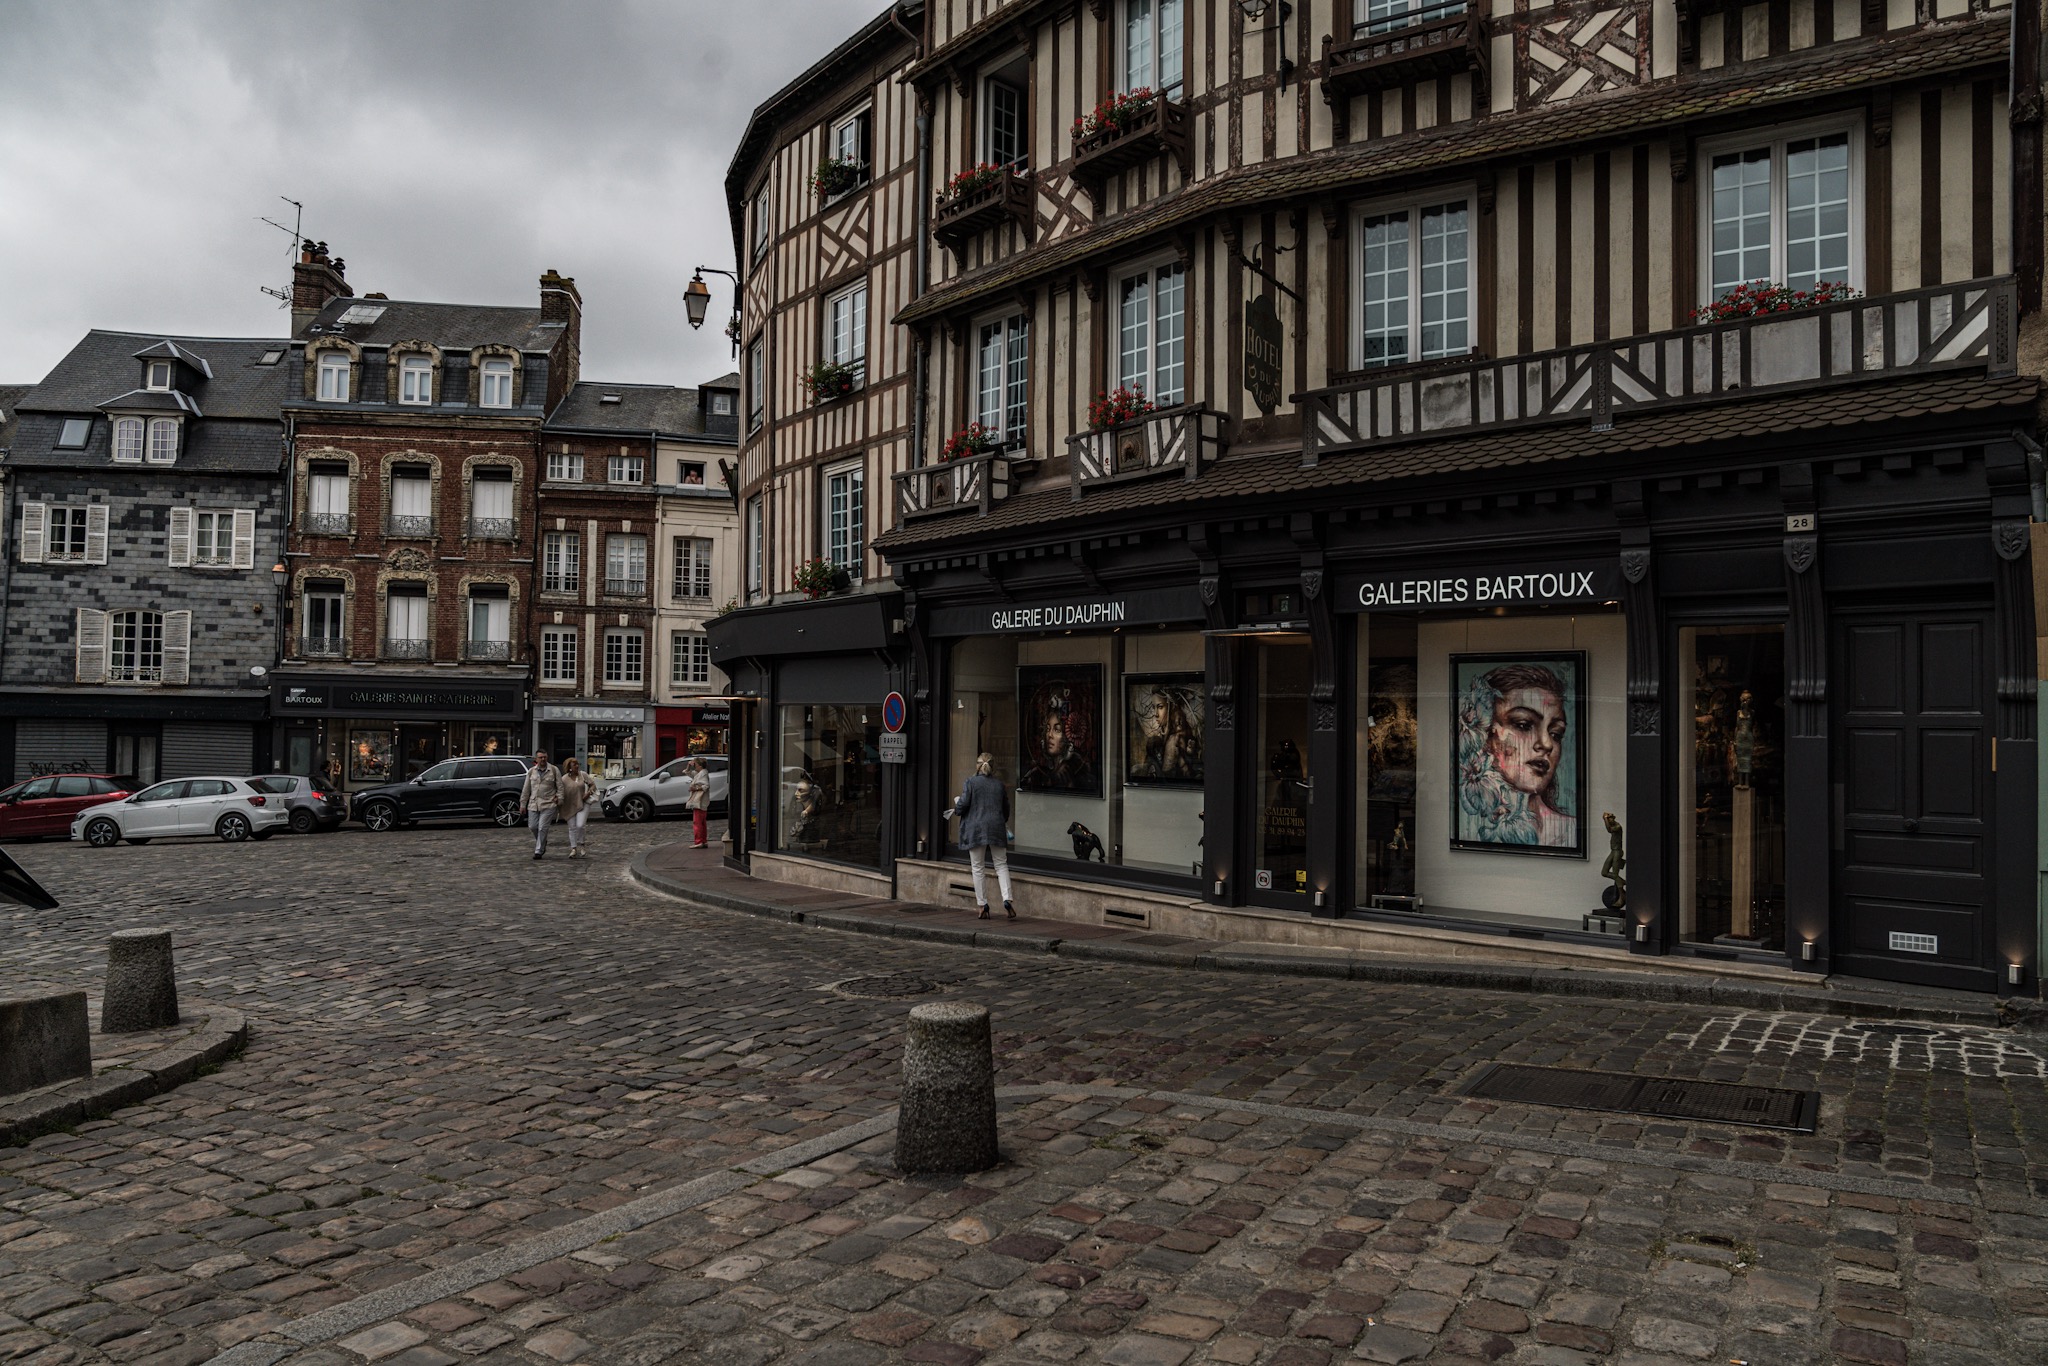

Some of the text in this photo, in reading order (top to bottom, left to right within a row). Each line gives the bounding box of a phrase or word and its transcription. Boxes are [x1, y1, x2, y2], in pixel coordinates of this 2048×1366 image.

[1247, 326, 1281, 370] HOTEL
[1260, 371, 1270, 385] DU
[1793, 518, 1808, 528] 28
[1358, 572, 1594, 606] GALERIES BARTOUX
[992, 601, 1124, 630] GALERIE DU DAUPHIN
[350, 692, 496, 705] GALERIE SAINTE CATHERINE
[552, 708, 614, 719] STELLA
[1265, 806, 1297, 816] GALERIE
[1272, 816, 1304, 826] DAUPHIN
